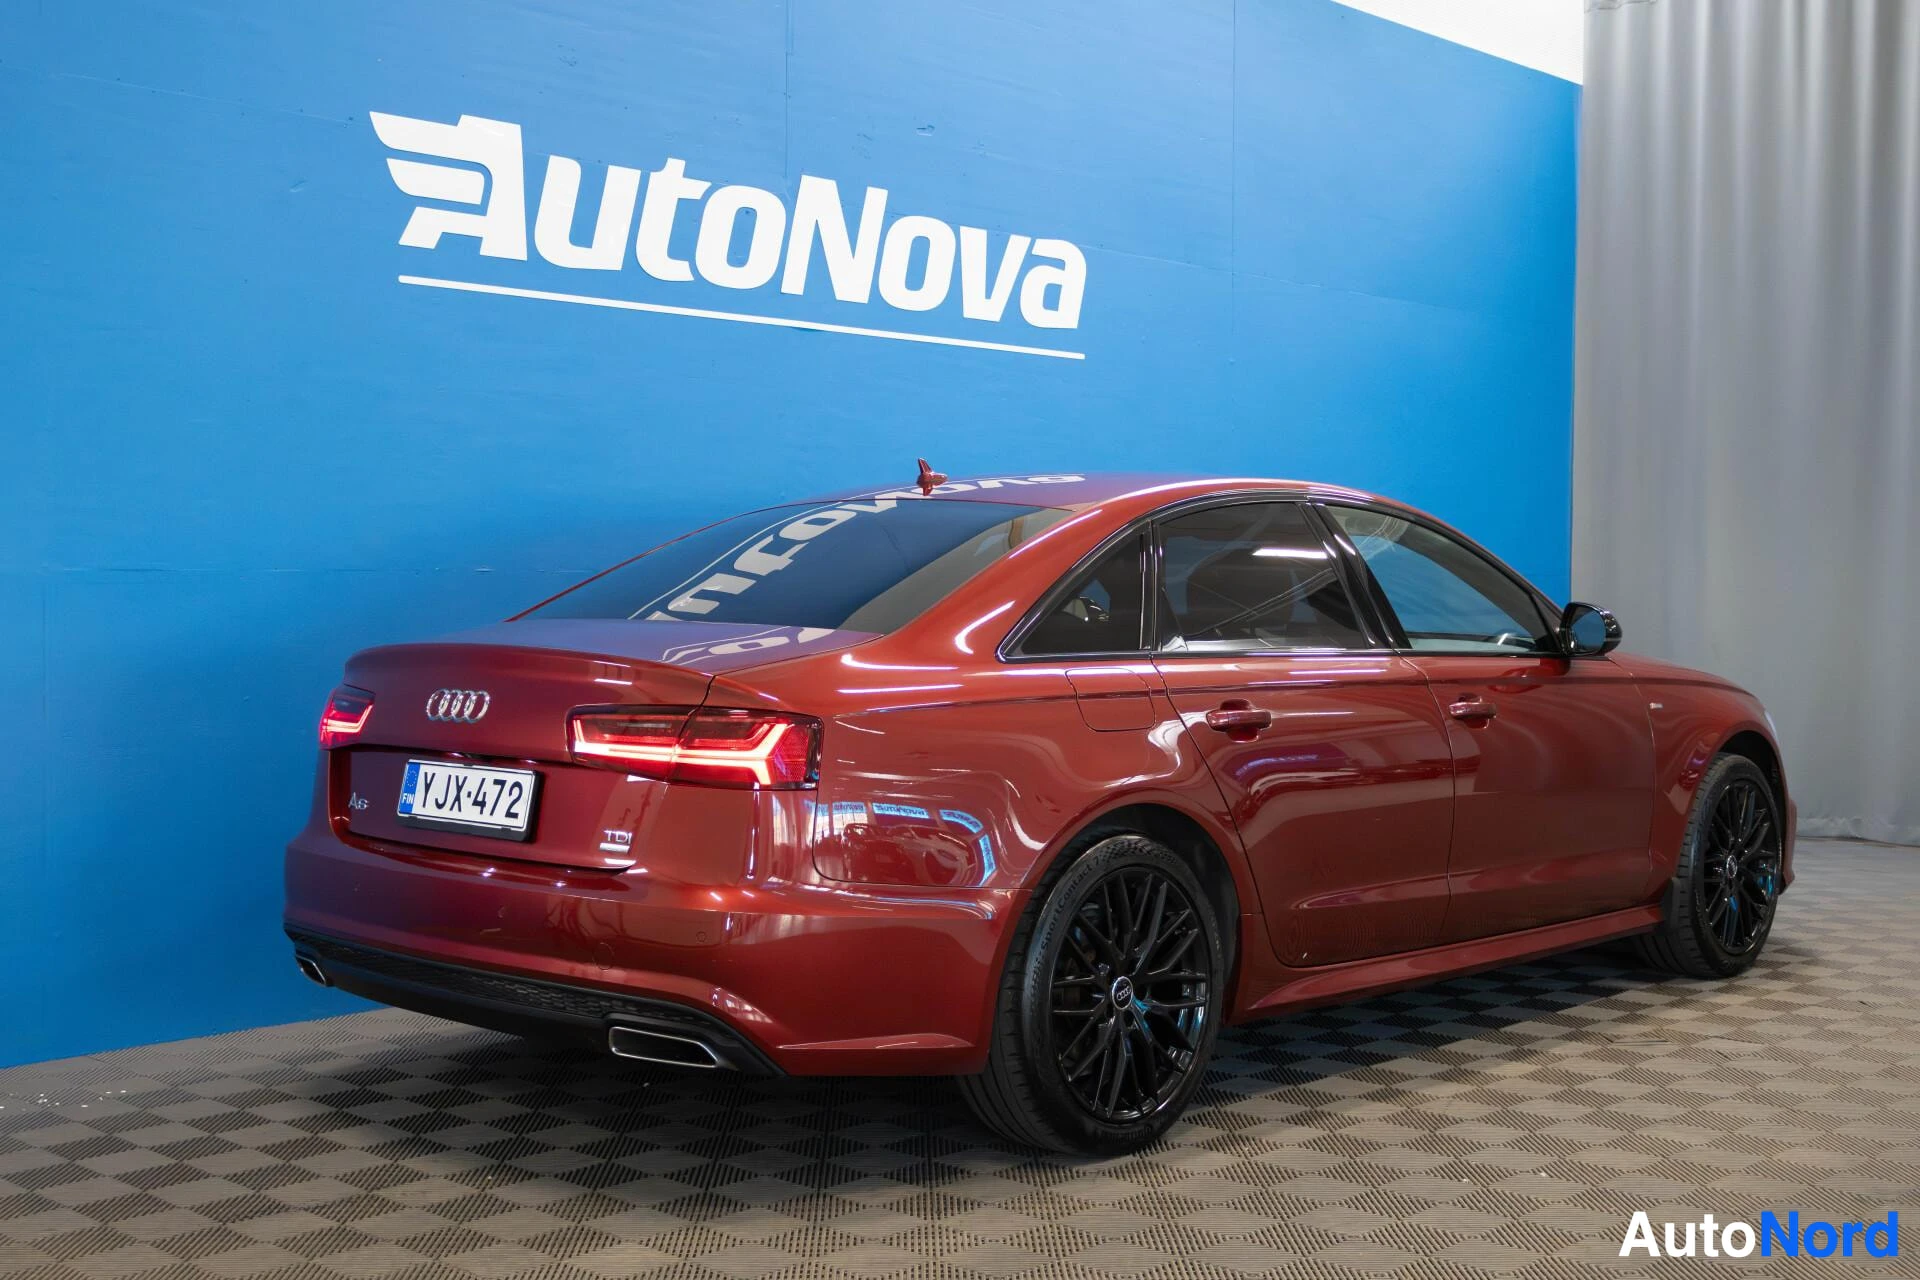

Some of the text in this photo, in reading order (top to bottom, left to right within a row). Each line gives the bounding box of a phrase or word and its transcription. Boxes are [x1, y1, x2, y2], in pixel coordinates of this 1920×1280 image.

[369, 111, 1088, 329] AutoNova
[347, 791, 369, 810] A6
[402, 792, 415, 804] FIN
[602, 829, 633, 845] TDI
